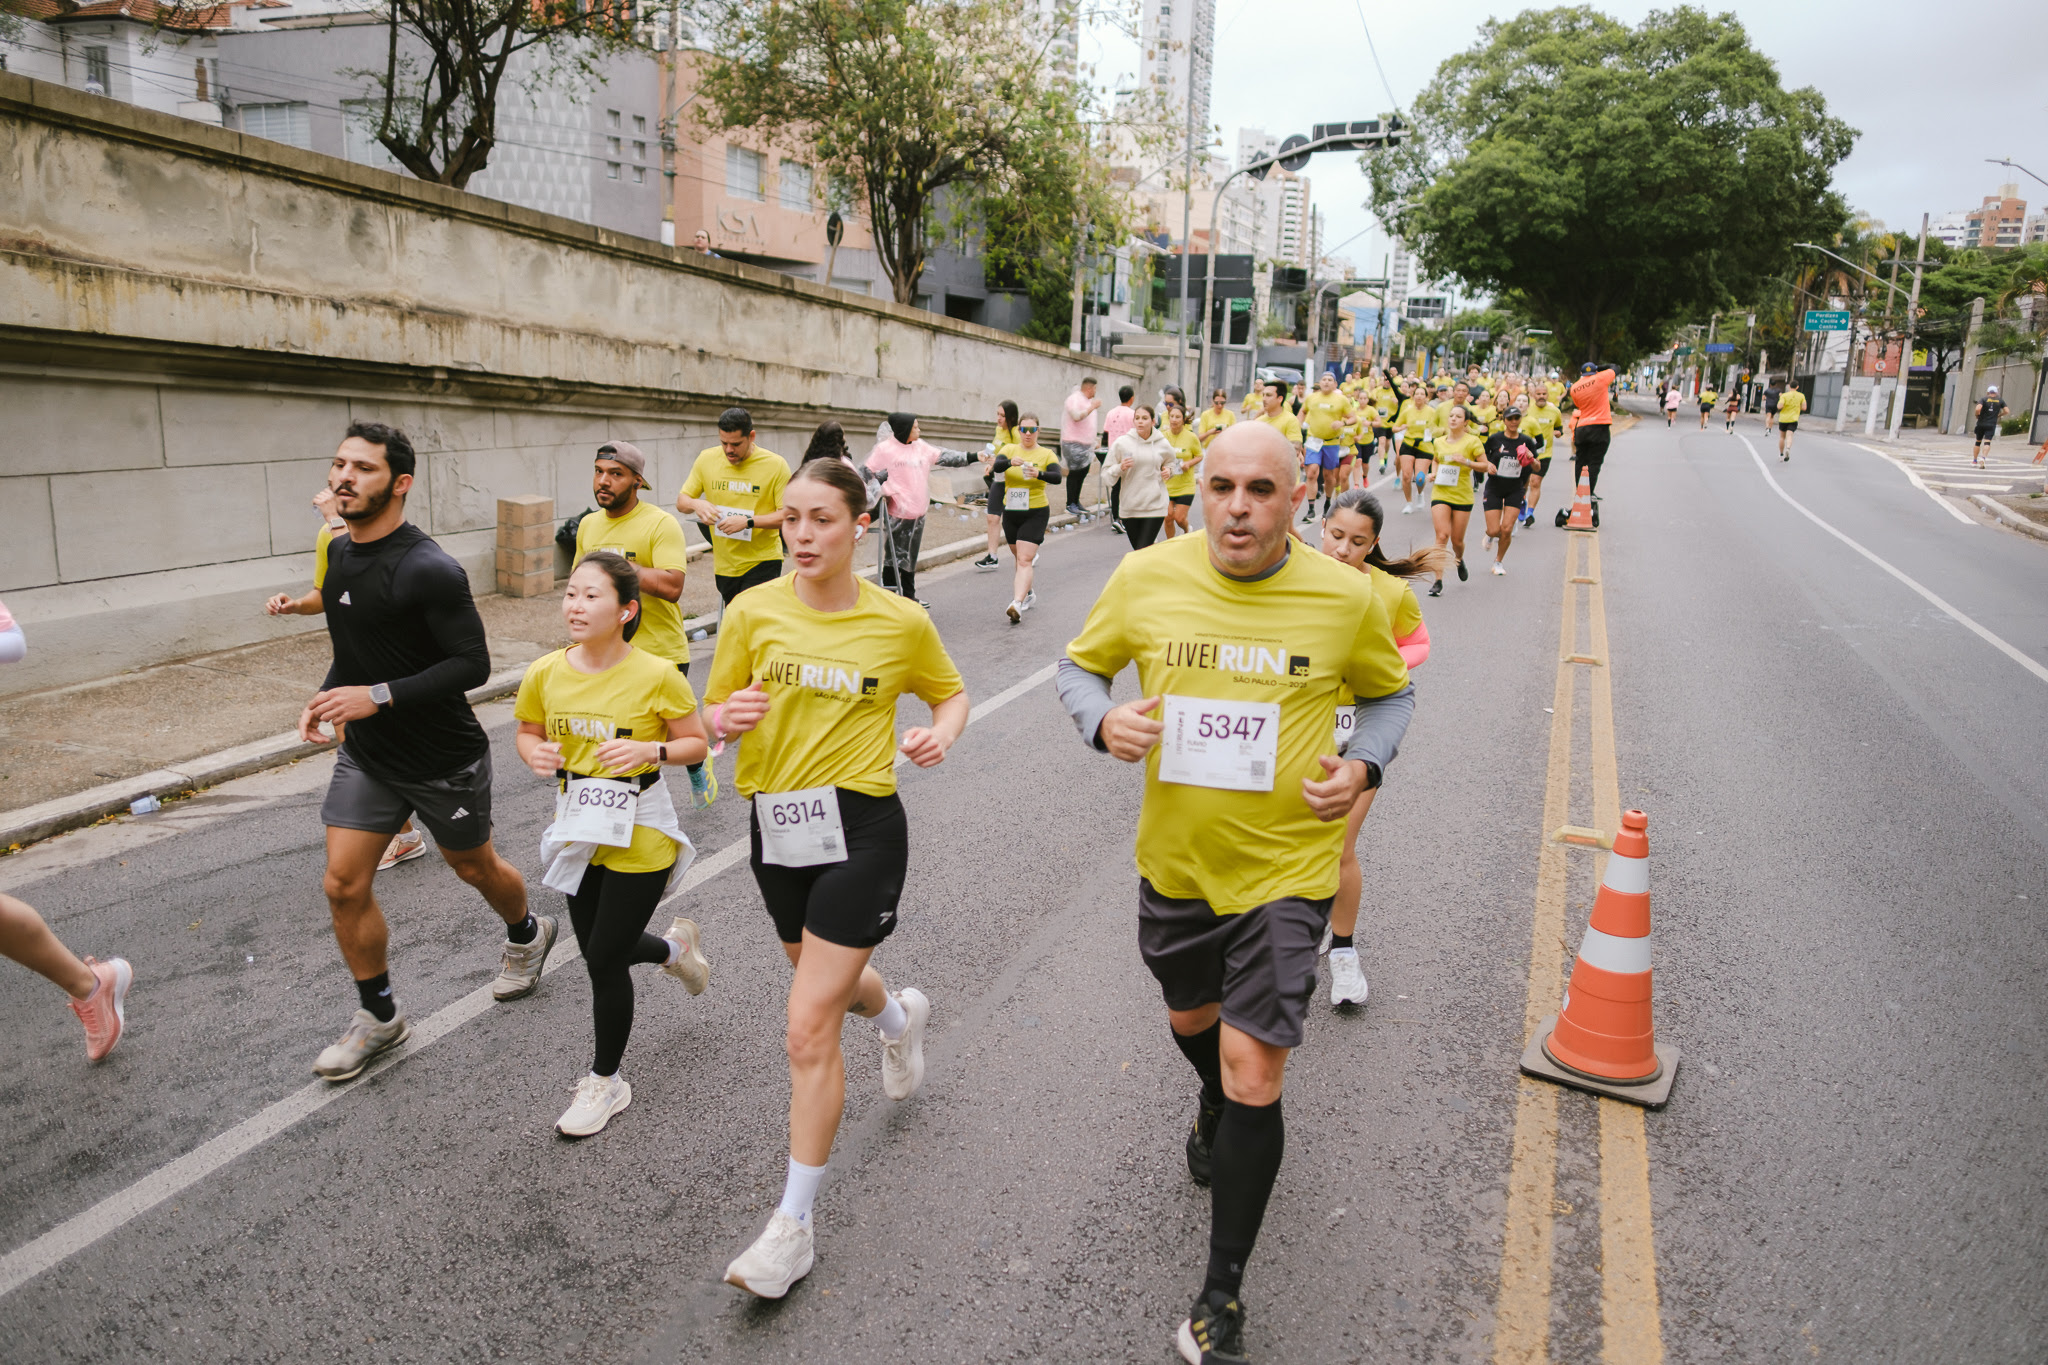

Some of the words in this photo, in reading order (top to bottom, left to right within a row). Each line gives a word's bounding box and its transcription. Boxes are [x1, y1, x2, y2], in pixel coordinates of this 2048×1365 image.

[1251, 678, 1277, 687] PAULO
[1198, 713, 1267, 741] 5347
[578, 787, 629, 810] 6332
[773, 799, 826, 825] 6314
